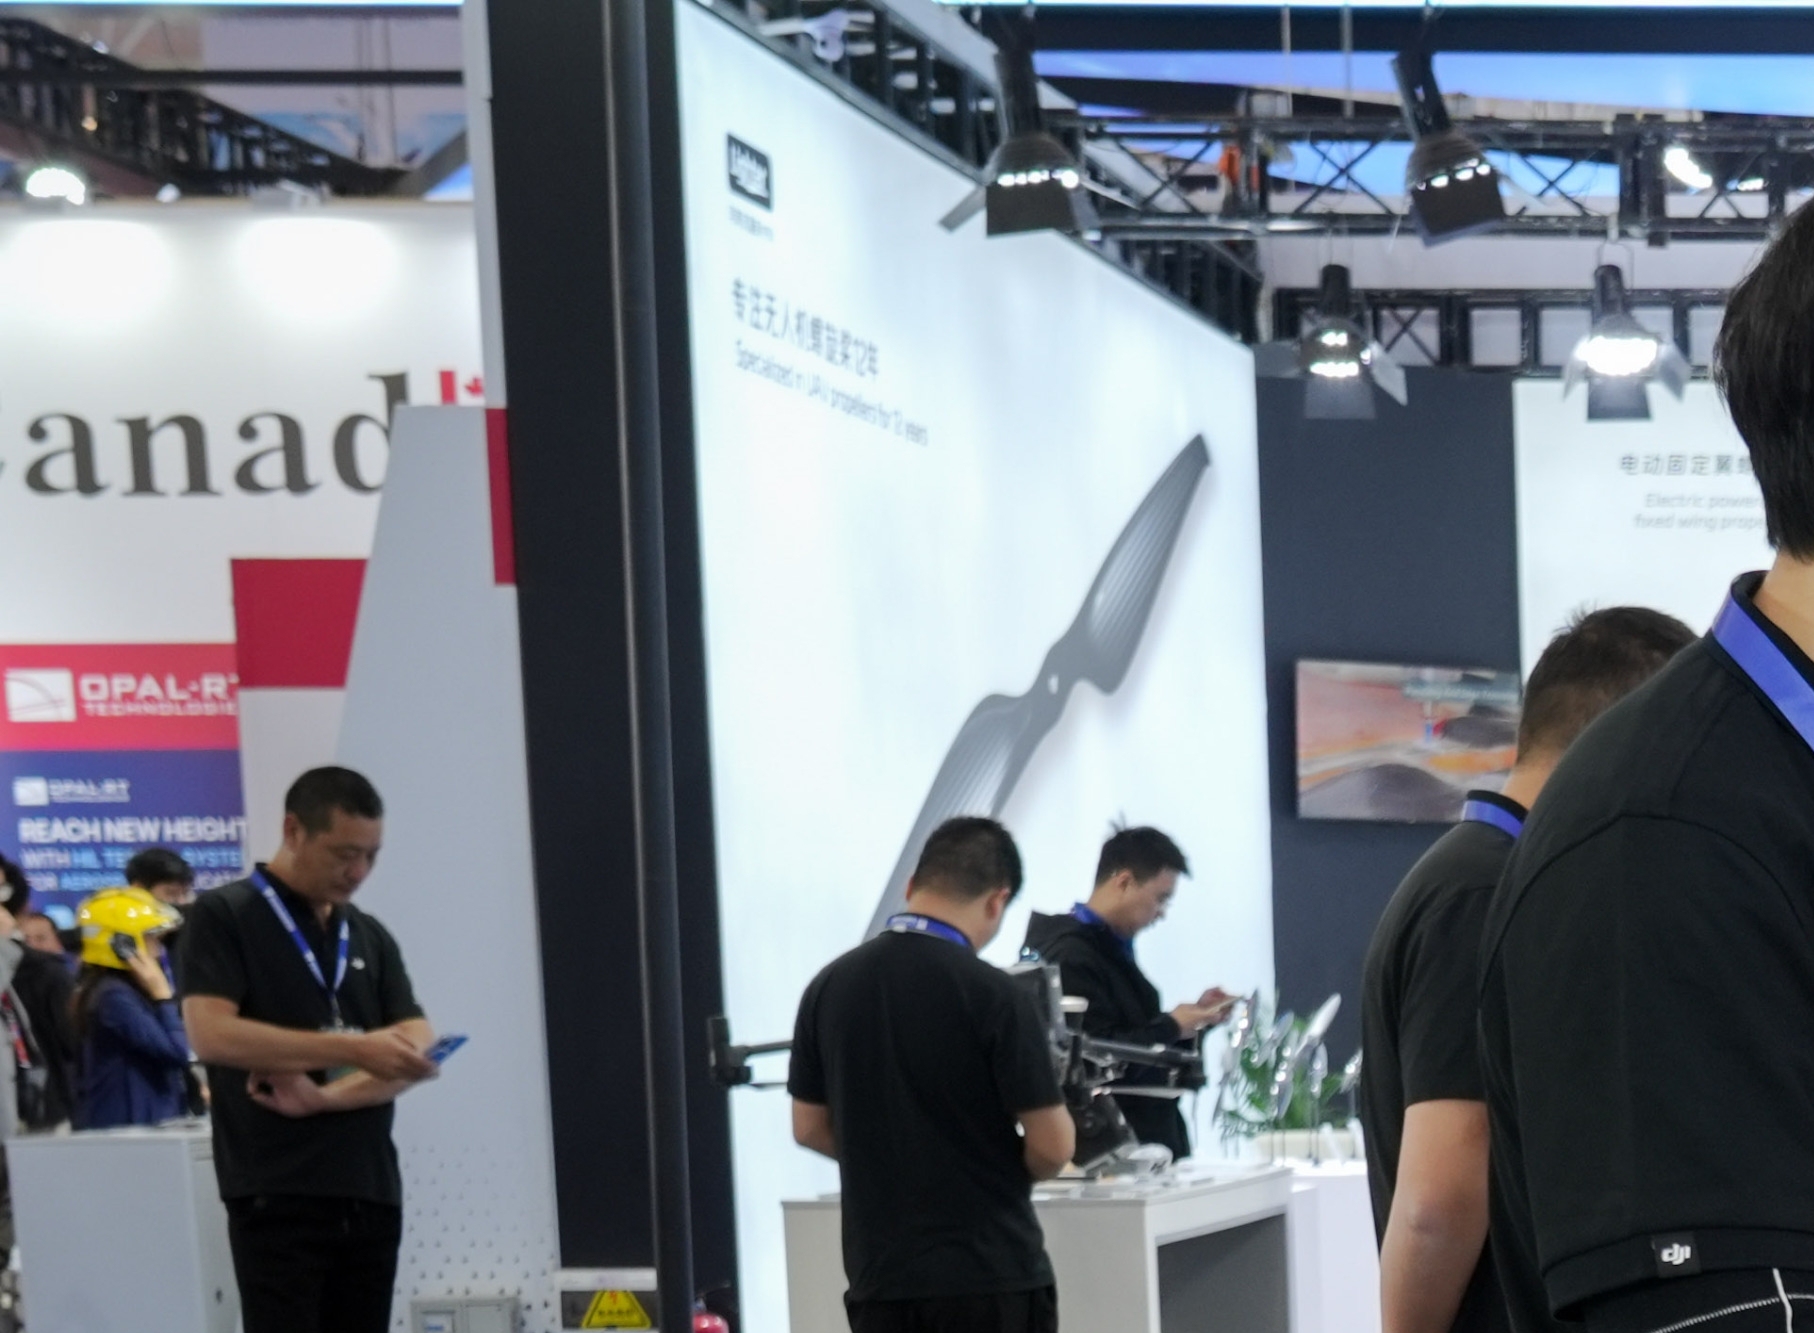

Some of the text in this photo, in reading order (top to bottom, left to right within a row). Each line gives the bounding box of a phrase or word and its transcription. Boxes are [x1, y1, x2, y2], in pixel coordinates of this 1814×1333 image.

[0, 370, 410, 498] anad
[18, 817, 102, 843] REACH
[103, 817, 162, 843] NEW
